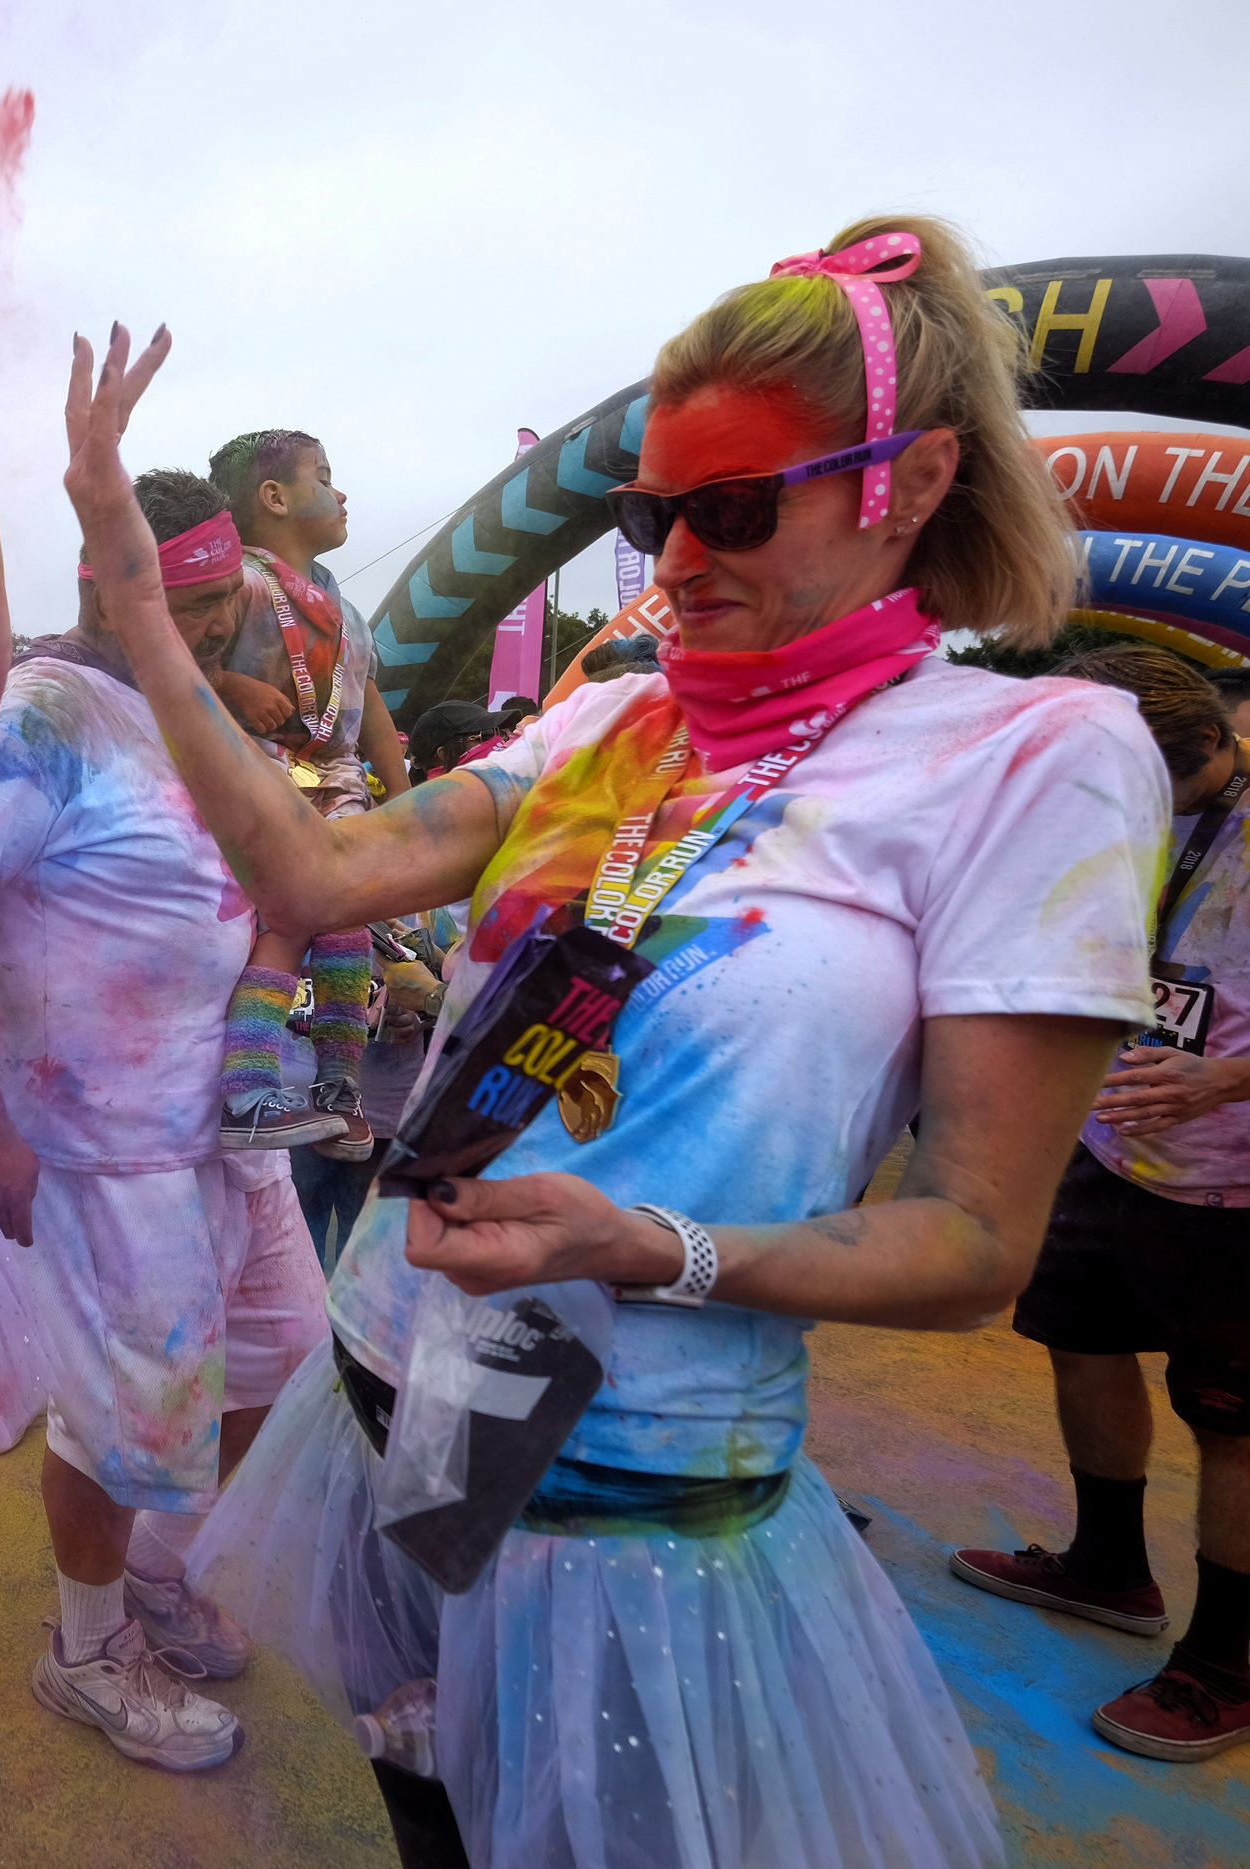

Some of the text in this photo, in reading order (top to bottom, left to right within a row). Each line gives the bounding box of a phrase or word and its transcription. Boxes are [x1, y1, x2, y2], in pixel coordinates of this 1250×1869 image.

[806, 447, 872, 478] THE COLOR RUN
[1046, 445, 1138, 501] ON
[1109, 538, 1214, 595] THE
[276, 602, 296, 628] RUN
[603, 593, 680, 645] HE
[290, 651, 308, 675] THE
[297, 673, 317, 715] COLOR
[315, 663, 345, 743] THE COLOR RUN
[737, 747, 799, 787] THE
[1223, 776, 1247, 797] 2018
[614, 811, 654, 848] THE
[1180, 850, 1202, 870] 2018
[588, 849, 641, 921] COLOR
[608, 829, 716, 944] COLOR RUN
[295, 1021, 310, 1032] THE
[547, 976, 623, 1044] THE
[503, 1022, 594, 1092] COL
[467, 1064, 545, 1128] RUN
